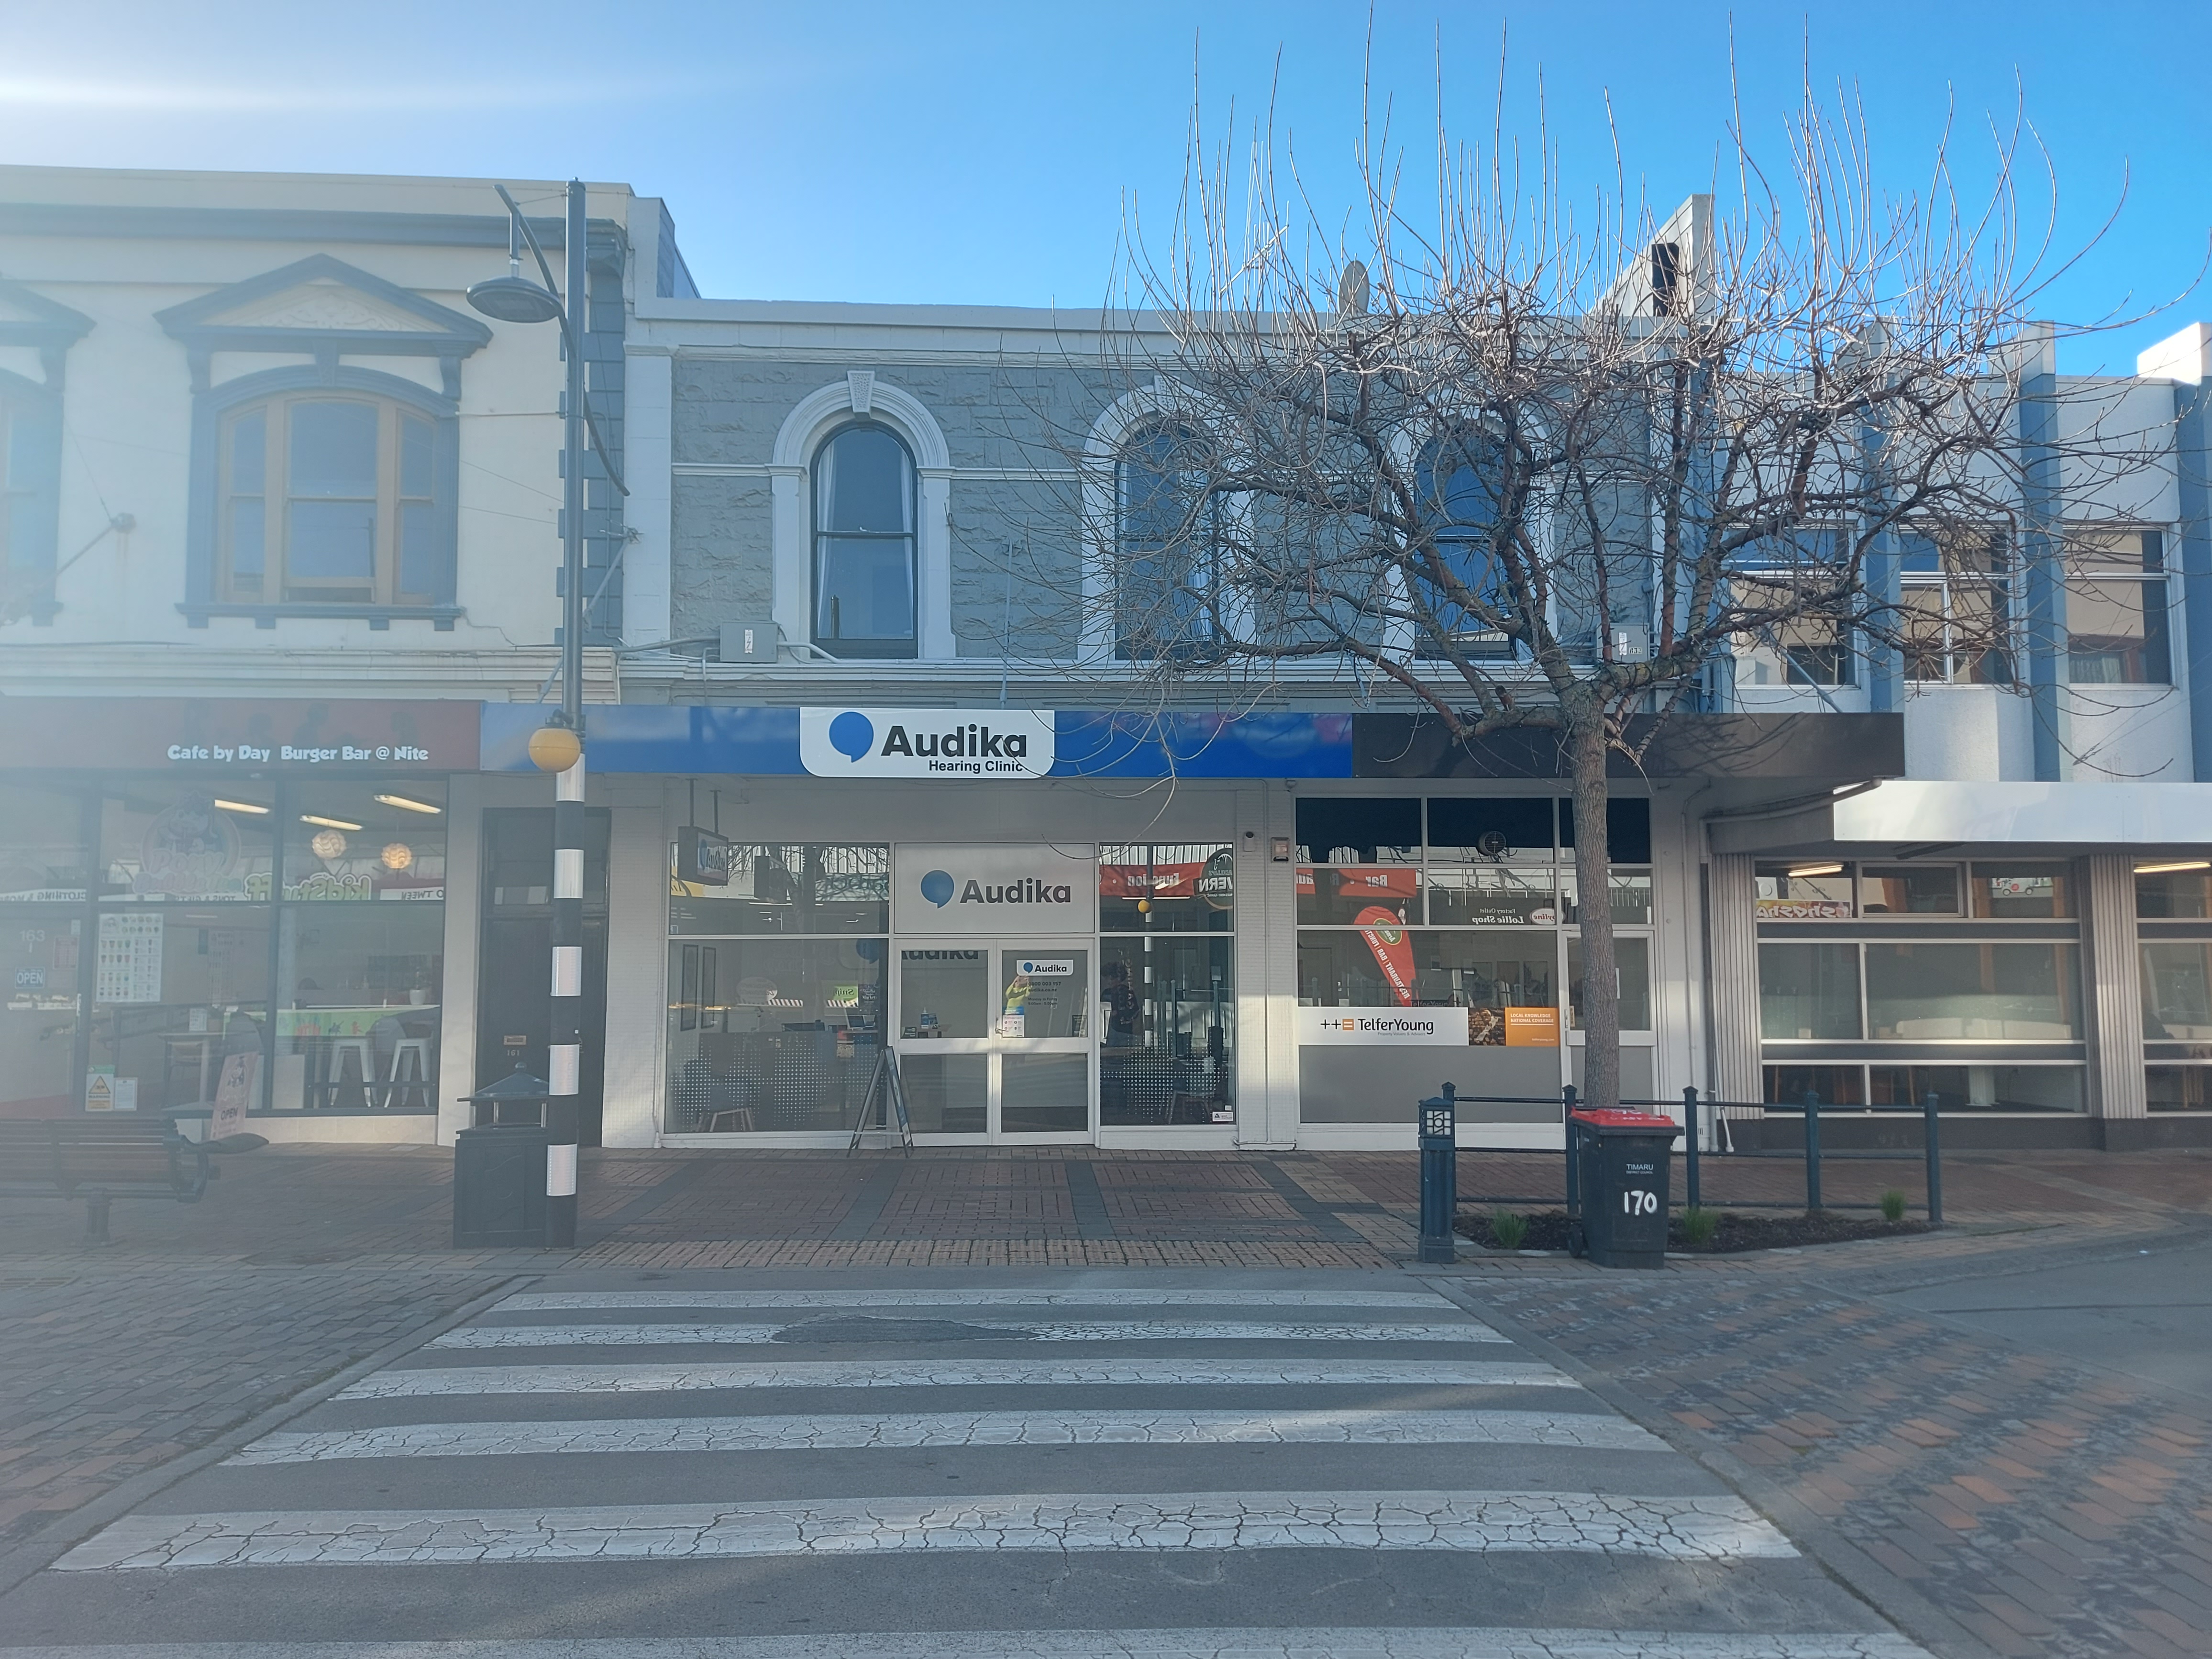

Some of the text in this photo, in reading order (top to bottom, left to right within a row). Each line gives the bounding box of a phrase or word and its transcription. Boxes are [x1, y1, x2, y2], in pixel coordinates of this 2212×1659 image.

[880, 723, 1027, 757] Audika
[167, 745, 429, 763] Cafe by Day Burger Bar @ Nite
[929, 760, 1023, 774] Hearing Clinic
[149, 850, 224, 874] Pony
[960, 877, 1071, 904] Audika
[20, 930, 45, 942] 163
[1034, 964, 1067, 973] Audika
[17, 972, 43, 984] OPEN
[1358, 1018, 1434, 1035] TelferYoung
[221, 1107, 238, 1121] OPEN
[1624, 1190, 1658, 1216] 170
